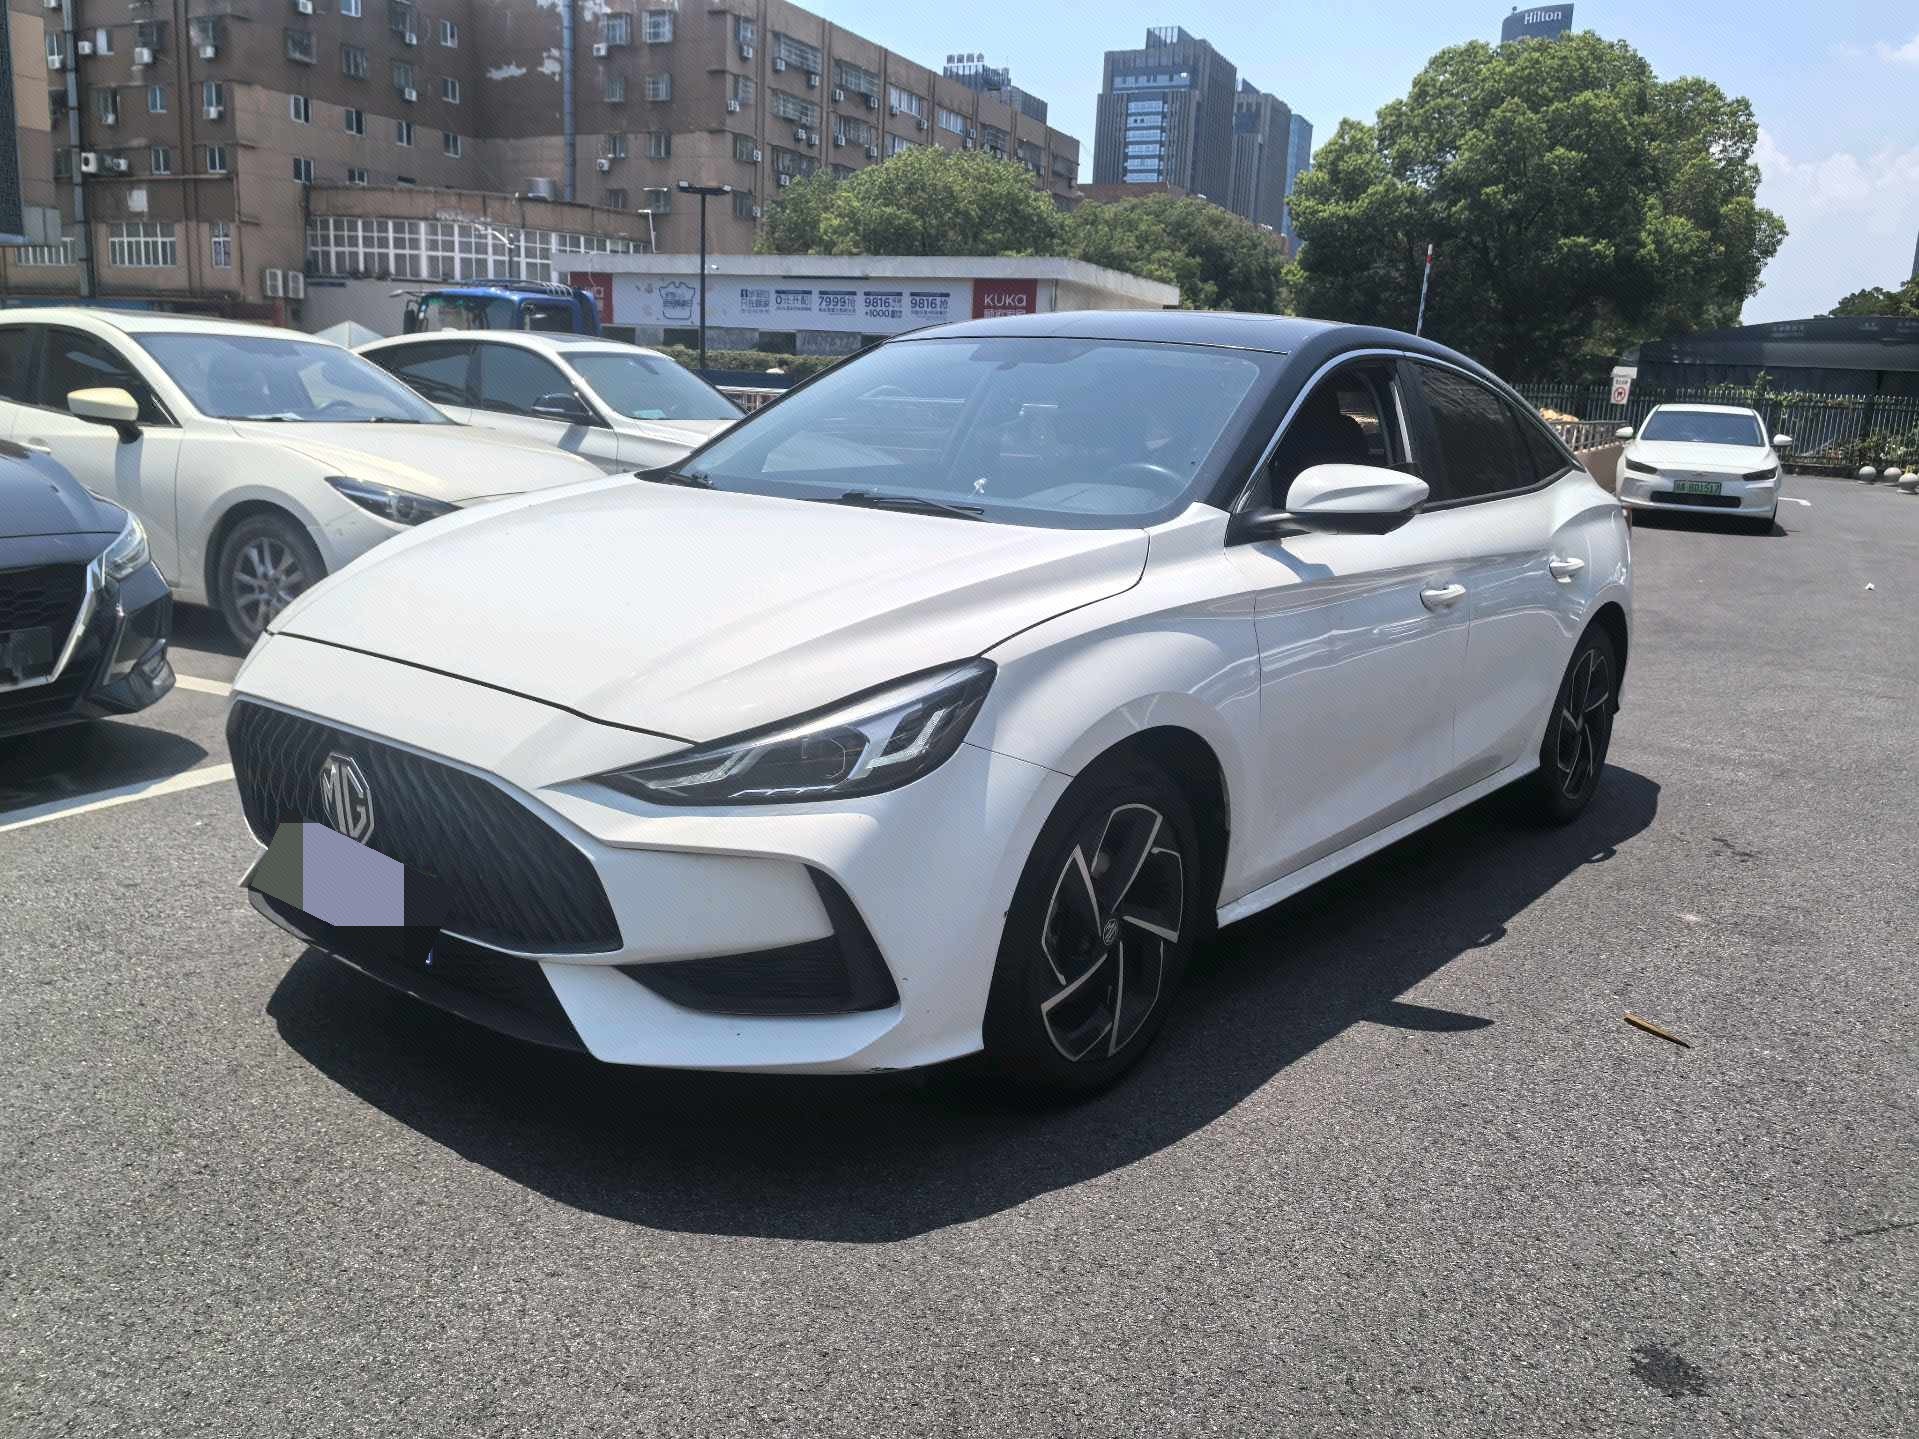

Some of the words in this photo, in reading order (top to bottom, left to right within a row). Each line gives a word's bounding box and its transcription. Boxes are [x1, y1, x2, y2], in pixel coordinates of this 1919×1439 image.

[1524, 11, 1562, 24] Hilton
[864, 297, 890, 308] 9816
[322, 763, 367, 838] MG
